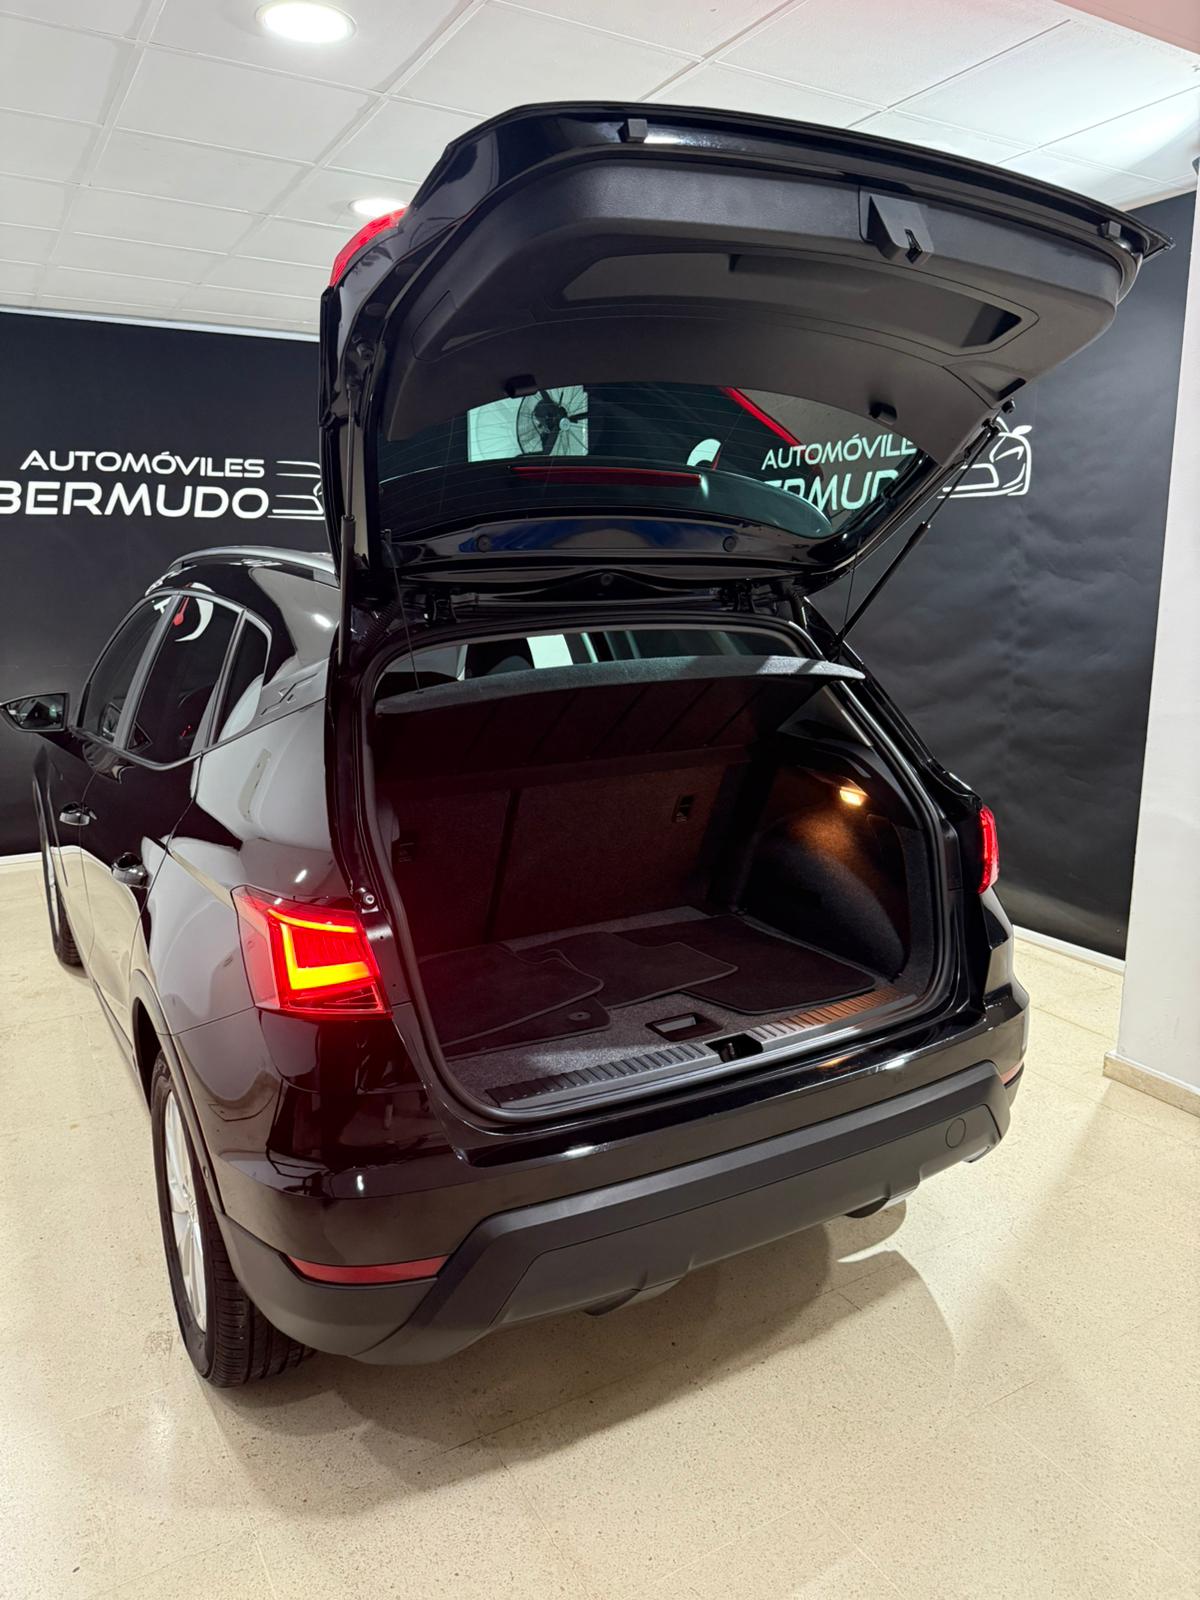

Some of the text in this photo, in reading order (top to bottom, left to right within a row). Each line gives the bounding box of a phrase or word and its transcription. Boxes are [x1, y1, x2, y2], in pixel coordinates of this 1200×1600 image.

[20, 449, 265, 478] AUTOMÓVILES
[761, 433, 917, 470] AUTOMÓVILE
[0, 480, 269, 519] BERMUDO
